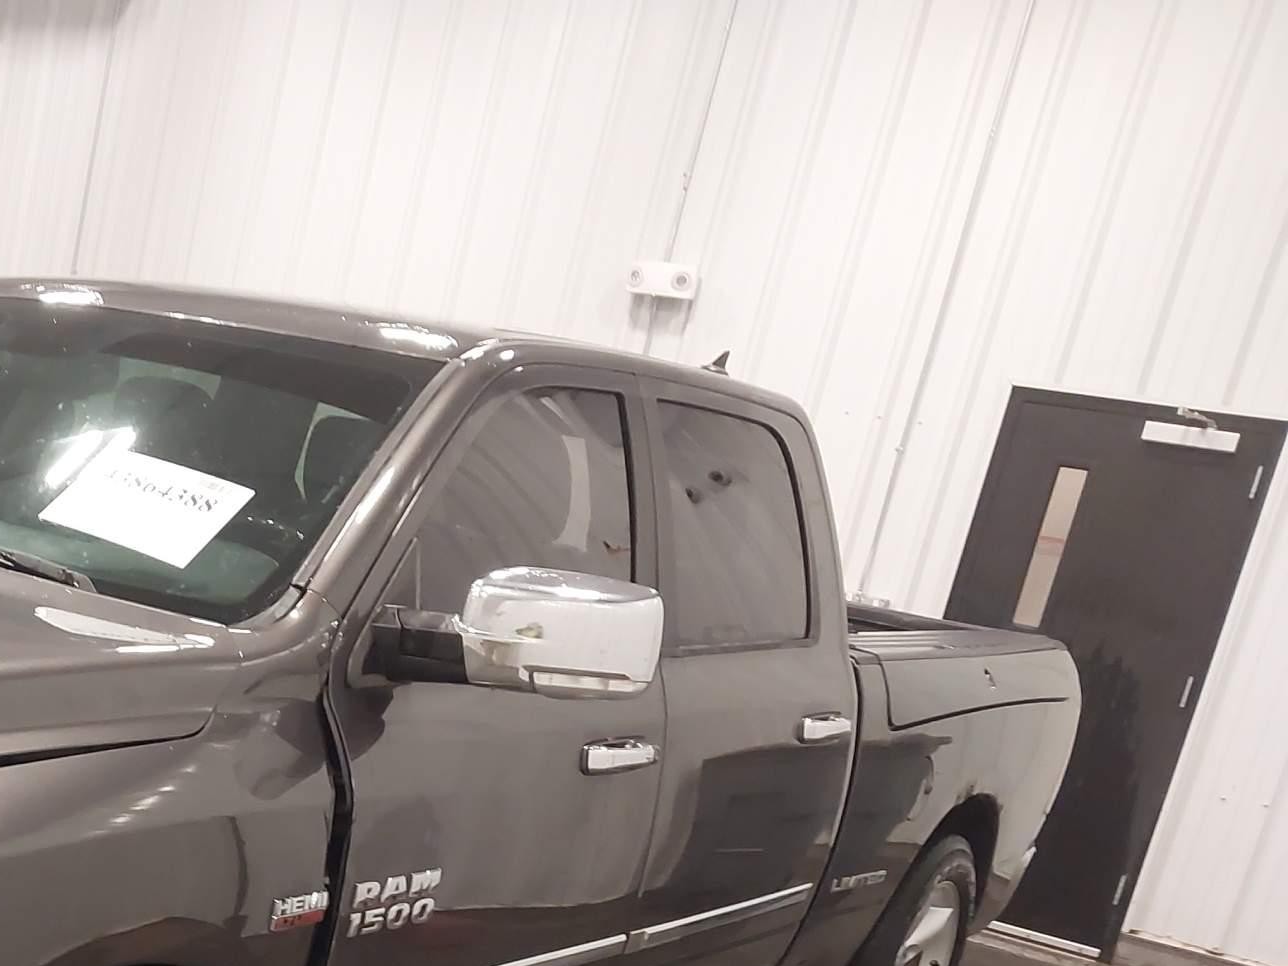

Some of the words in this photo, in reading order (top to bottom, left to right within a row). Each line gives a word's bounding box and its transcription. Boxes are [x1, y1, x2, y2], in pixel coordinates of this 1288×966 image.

[273, 891, 329, 917] HEMI
[352, 867, 443, 908] RAM
[346, 897, 435, 938] 1500
